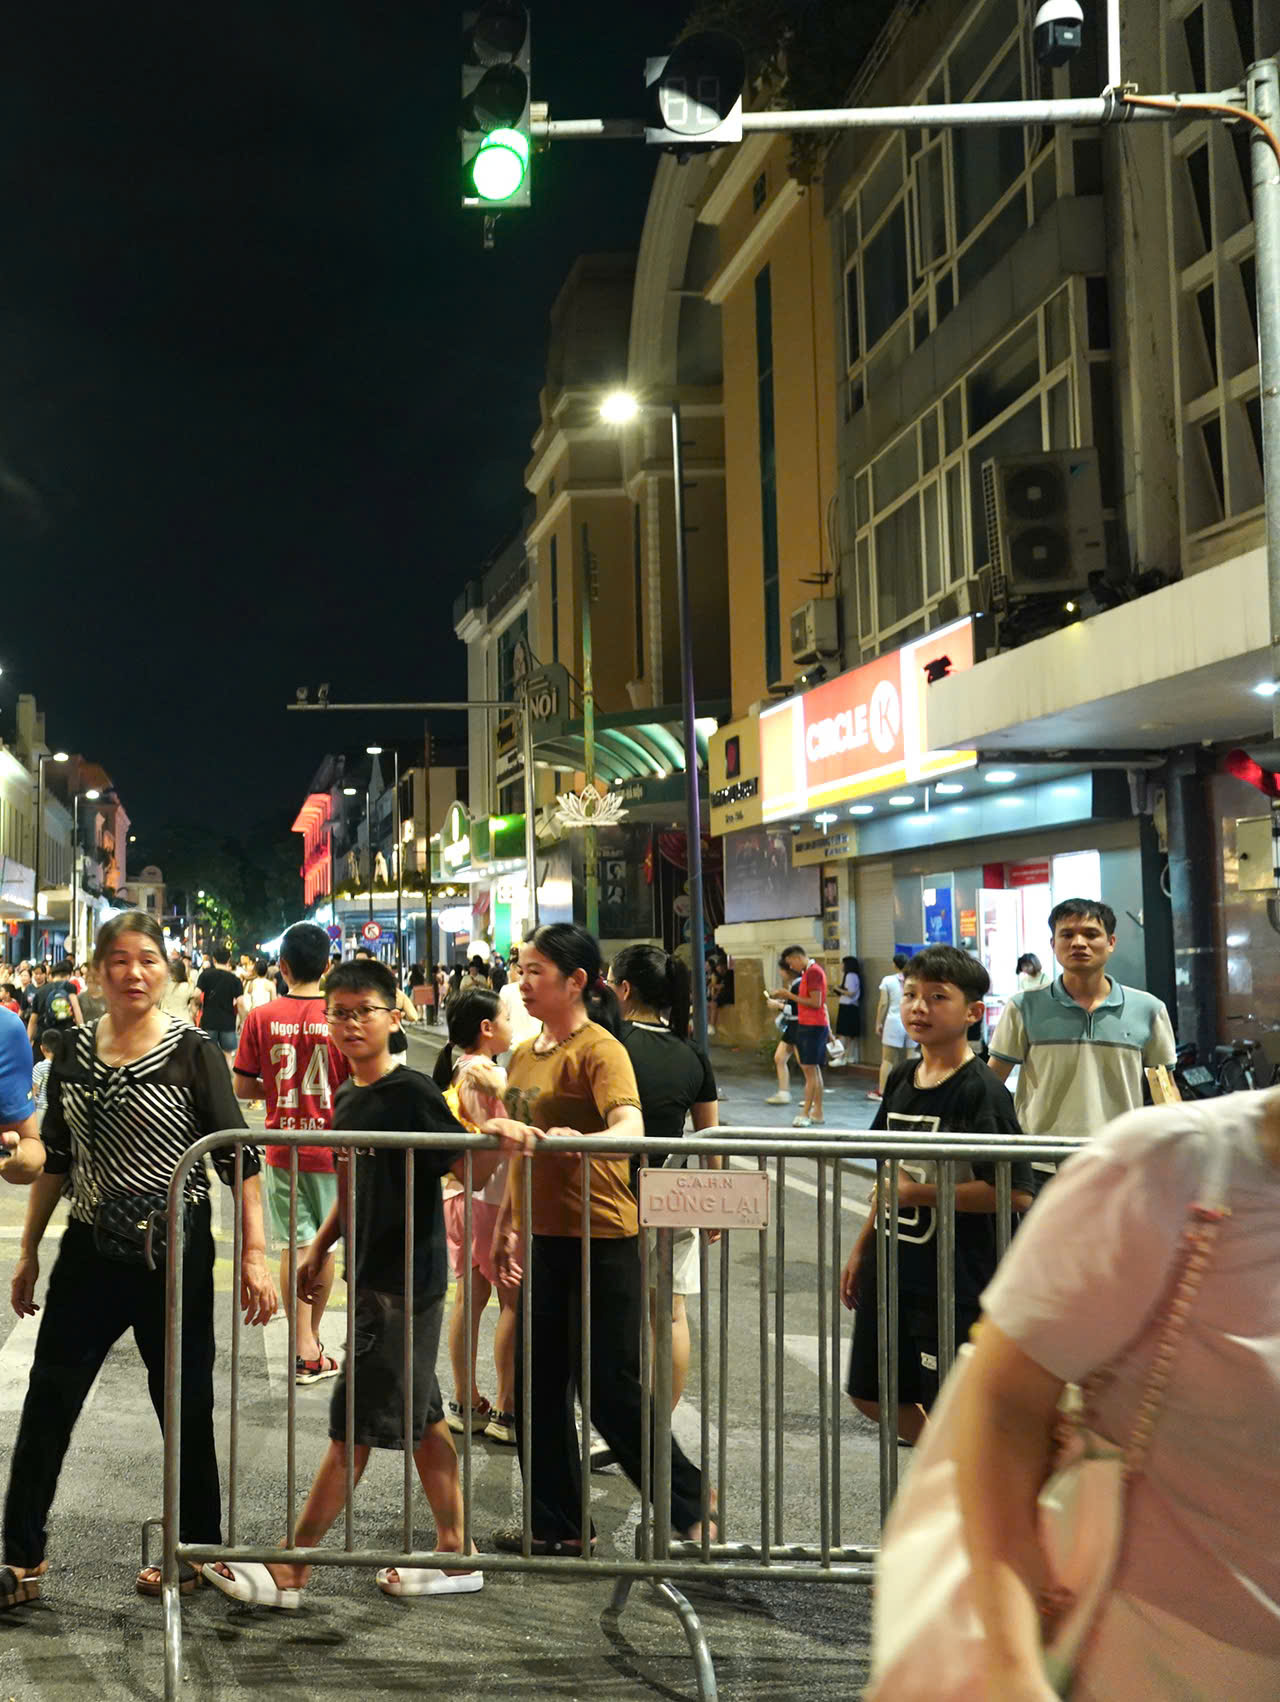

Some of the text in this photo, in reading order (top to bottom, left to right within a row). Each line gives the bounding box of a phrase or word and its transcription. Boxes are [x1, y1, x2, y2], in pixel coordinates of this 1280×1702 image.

[806, 704, 868, 762] CIRCLE
[270, 1021, 329, 1038] Ngọc Long
[270, 1043, 332, 1109] 24
[280, 1117, 326, 1130] FC 5A3
[676, 1176, 733, 1189] C.A.H.N
[648, 1188, 760, 1217] DỪNG LẠI
